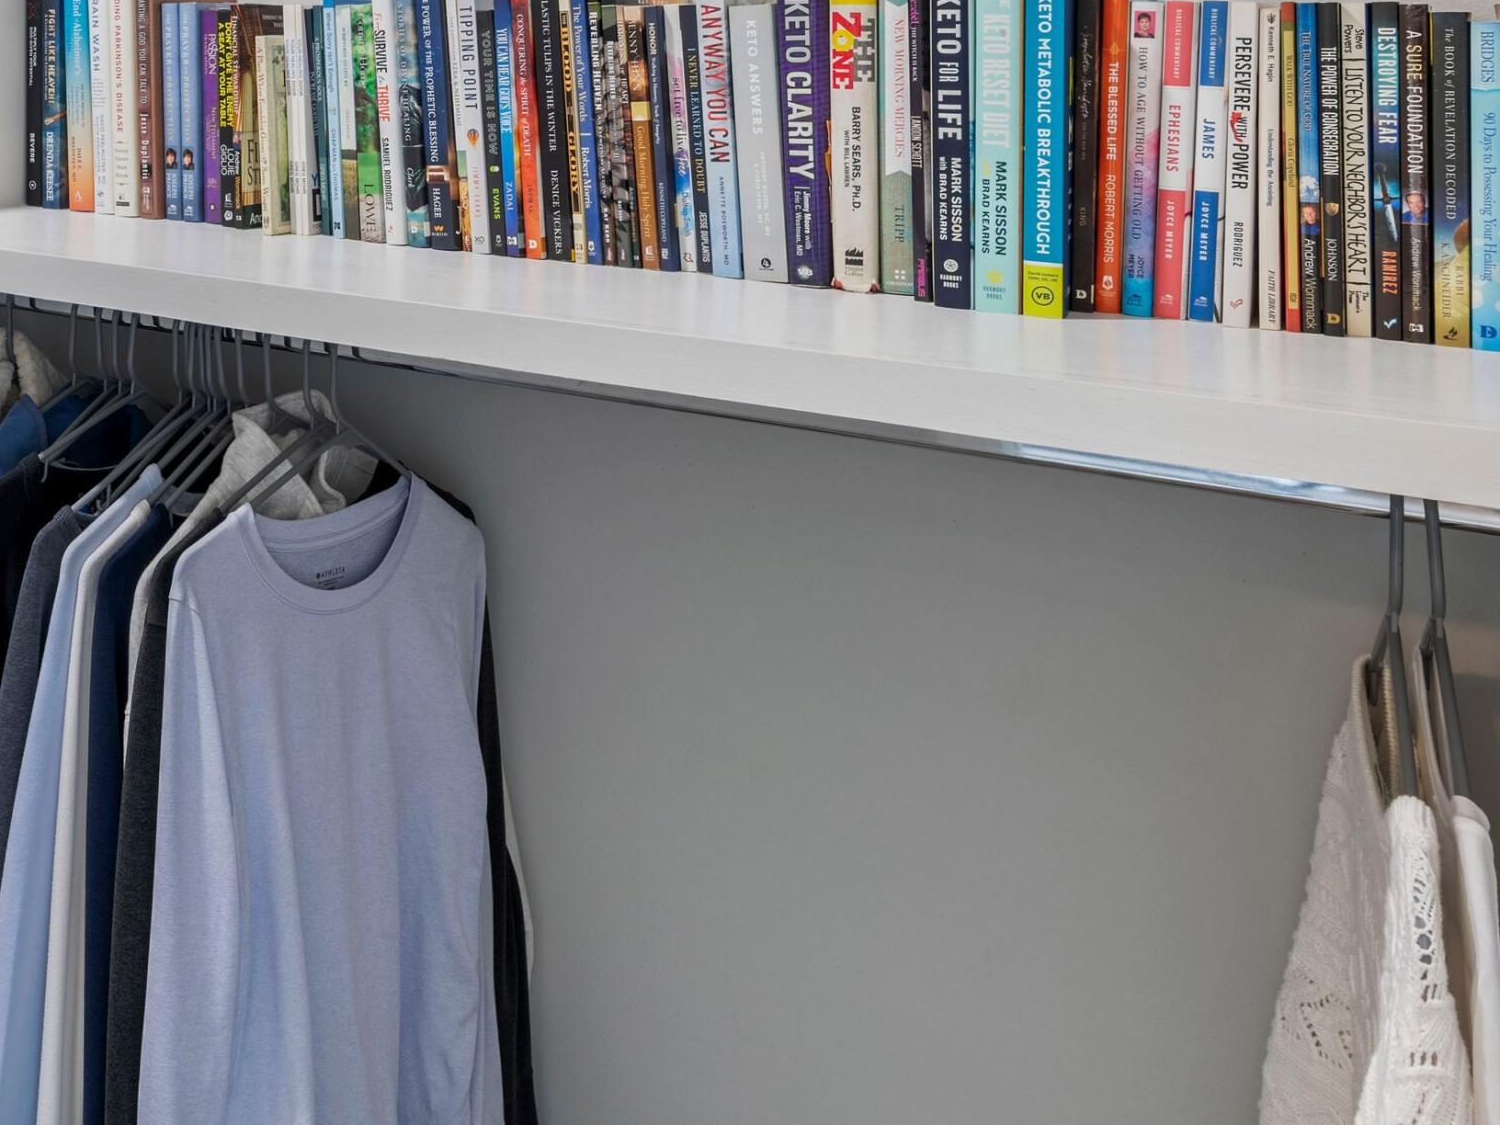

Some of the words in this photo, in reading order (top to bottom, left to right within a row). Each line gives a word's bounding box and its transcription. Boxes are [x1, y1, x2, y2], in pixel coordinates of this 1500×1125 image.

[422, 5, 430, 37] POWER
[459, 6, 474, 62] TIPPING
[1407, 30, 1422, 38] A
[92, 35, 100, 72] WASH
[374, 30, 387, 73] SURVIVE
[482, 31, 492, 65] YOUR
[542, 38, 553, 72] TULIPS
[701, 4, 725, 80] ANYWAY
[832, 12, 861, 89] ZONE
[854, 18, 875, 82] THE
[1321, 47, 1336, 62] THE
[1481, 31, 1495, 82] BRIDGES
[219, 57, 226, 69] AT
[545, 75, 554, 86] IN
[939, 62, 960, 82] FOR
[1037, 38, 1052, 123] METABOLIC
[1109, 62, 1118, 83] THE
[1233, 37, 1251, 111] PERSEVERE
[1321, 65, 1336, 96] POWER
[1377, 27, 1396, 106] DESTROYING
[1406, 44, 1422, 80] SURE
[48, 64, 56, 103] HEAVEN!
[426, 66, 436, 119] PROPHETIC
[463, 69, 477, 109] POINT
[484, 71, 494, 101] TIME
[546, 88, 555, 109] THE
[1344, 67, 1363, 106] LISTEN
[226, 95, 234, 127] ENEMY
[378, 85, 390, 122] THRIVE
[486, 107, 495, 117] IS
[708, 87, 728, 120] YOU
[937, 89, 962, 140] LIFE
[1108, 86, 1118, 133] BLESSED
[1322, 99, 1335, 109] OF
[1345, 110, 1363, 123] TO
[1484, 112, 1495, 125] 90
[140, 113, 149, 134] Jesse
[429, 120, 439, 162] BLESSING
[487, 120, 498, 155] NOW
[547, 111, 557, 152] WINTER
[787, 71, 814, 178] CLARITY
[851, 106, 861, 142] BARRY
[1166, 105, 1181, 172] EPHESIANS
[1202, 118, 1215, 159] JAMES
[1236, 117, 1247, 138] WITH
[1377, 112, 1397, 144] FEAR
[1407, 86, 1424, 174] FOUNDATION
[1482, 127, 1496, 152] Days
[46, 131, 54, 168] DRENDA
[141, 140, 150, 180] Duplantis
[227, 148, 235, 175] LOUIE
[381, 137, 389, 168] SAMUEL
[710, 131, 730, 162] CAN
[1107, 137, 1117, 160] LIFE
[1323, 112, 1339, 175] CONSECRATION
[1344, 126, 1364, 161] YOUR
[1484, 154, 1495, 164] to
[851, 145, 861, 181] SEARS,
[939, 156, 947, 170] with
[951, 157, 961, 193] MARK
[996, 161, 1007, 201] MARK
[1232, 143, 1249, 189] POWER
[46, 170, 54, 201] KEESEE
[383, 169, 393, 211] RODRIGUEZ
[433, 188, 441, 217] HAGEE
[493, 189, 501, 219] EVANS
[551, 170, 560, 207] DENICE
[982, 179, 990, 207] BRAD
[1036, 129, 1052, 254] BREAKTHROUGH
[1104, 174, 1116, 218] ROBERT
[1345, 164, 1365, 229] NEIGHBOR'S
[1482, 167, 1496, 216] Possessing
[553, 210, 563, 254] VICKERS
[939, 202, 947, 239] KEARNS
[952, 196, 962, 242] SISSON
[982, 211, 990, 253] KEARNS
[996, 205, 1007, 255] SISSON
[1483, 218, 1496, 240] Your
[1104, 221, 1114, 263] MORRIS
[1233, 222, 1243, 267] RODRIGUEZ
[1327, 238, 1338, 281] JOHNSON
[1347, 233, 1366, 275] HEART
[1411, 237, 1421, 268] Andrew
[1382, 251, 1397, 293] RAMIREZ
[1482, 243, 1497, 281] Healing
[1411, 270, 1421, 311] Wommack
